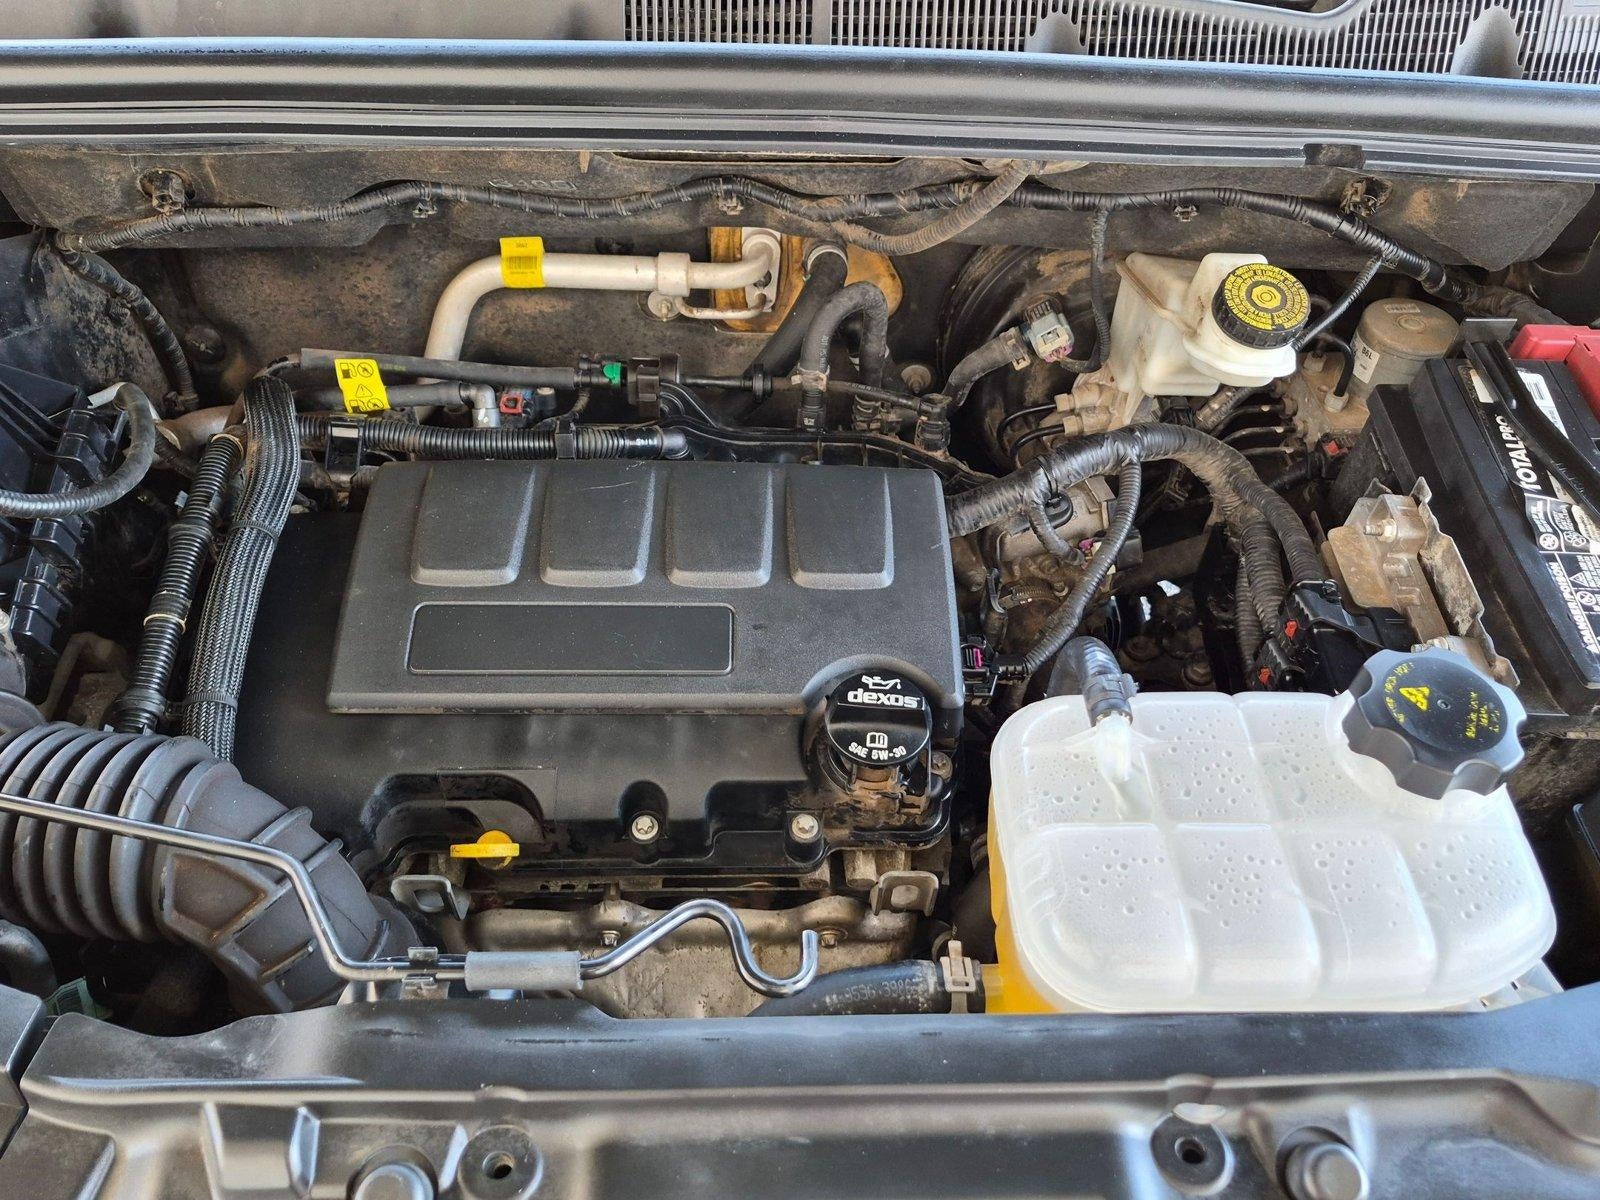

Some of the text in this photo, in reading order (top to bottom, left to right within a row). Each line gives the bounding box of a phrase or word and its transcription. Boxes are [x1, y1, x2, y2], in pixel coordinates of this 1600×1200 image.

[847, 688, 920, 709] dexos
[848, 742, 907, 760] SAE 5W-30
